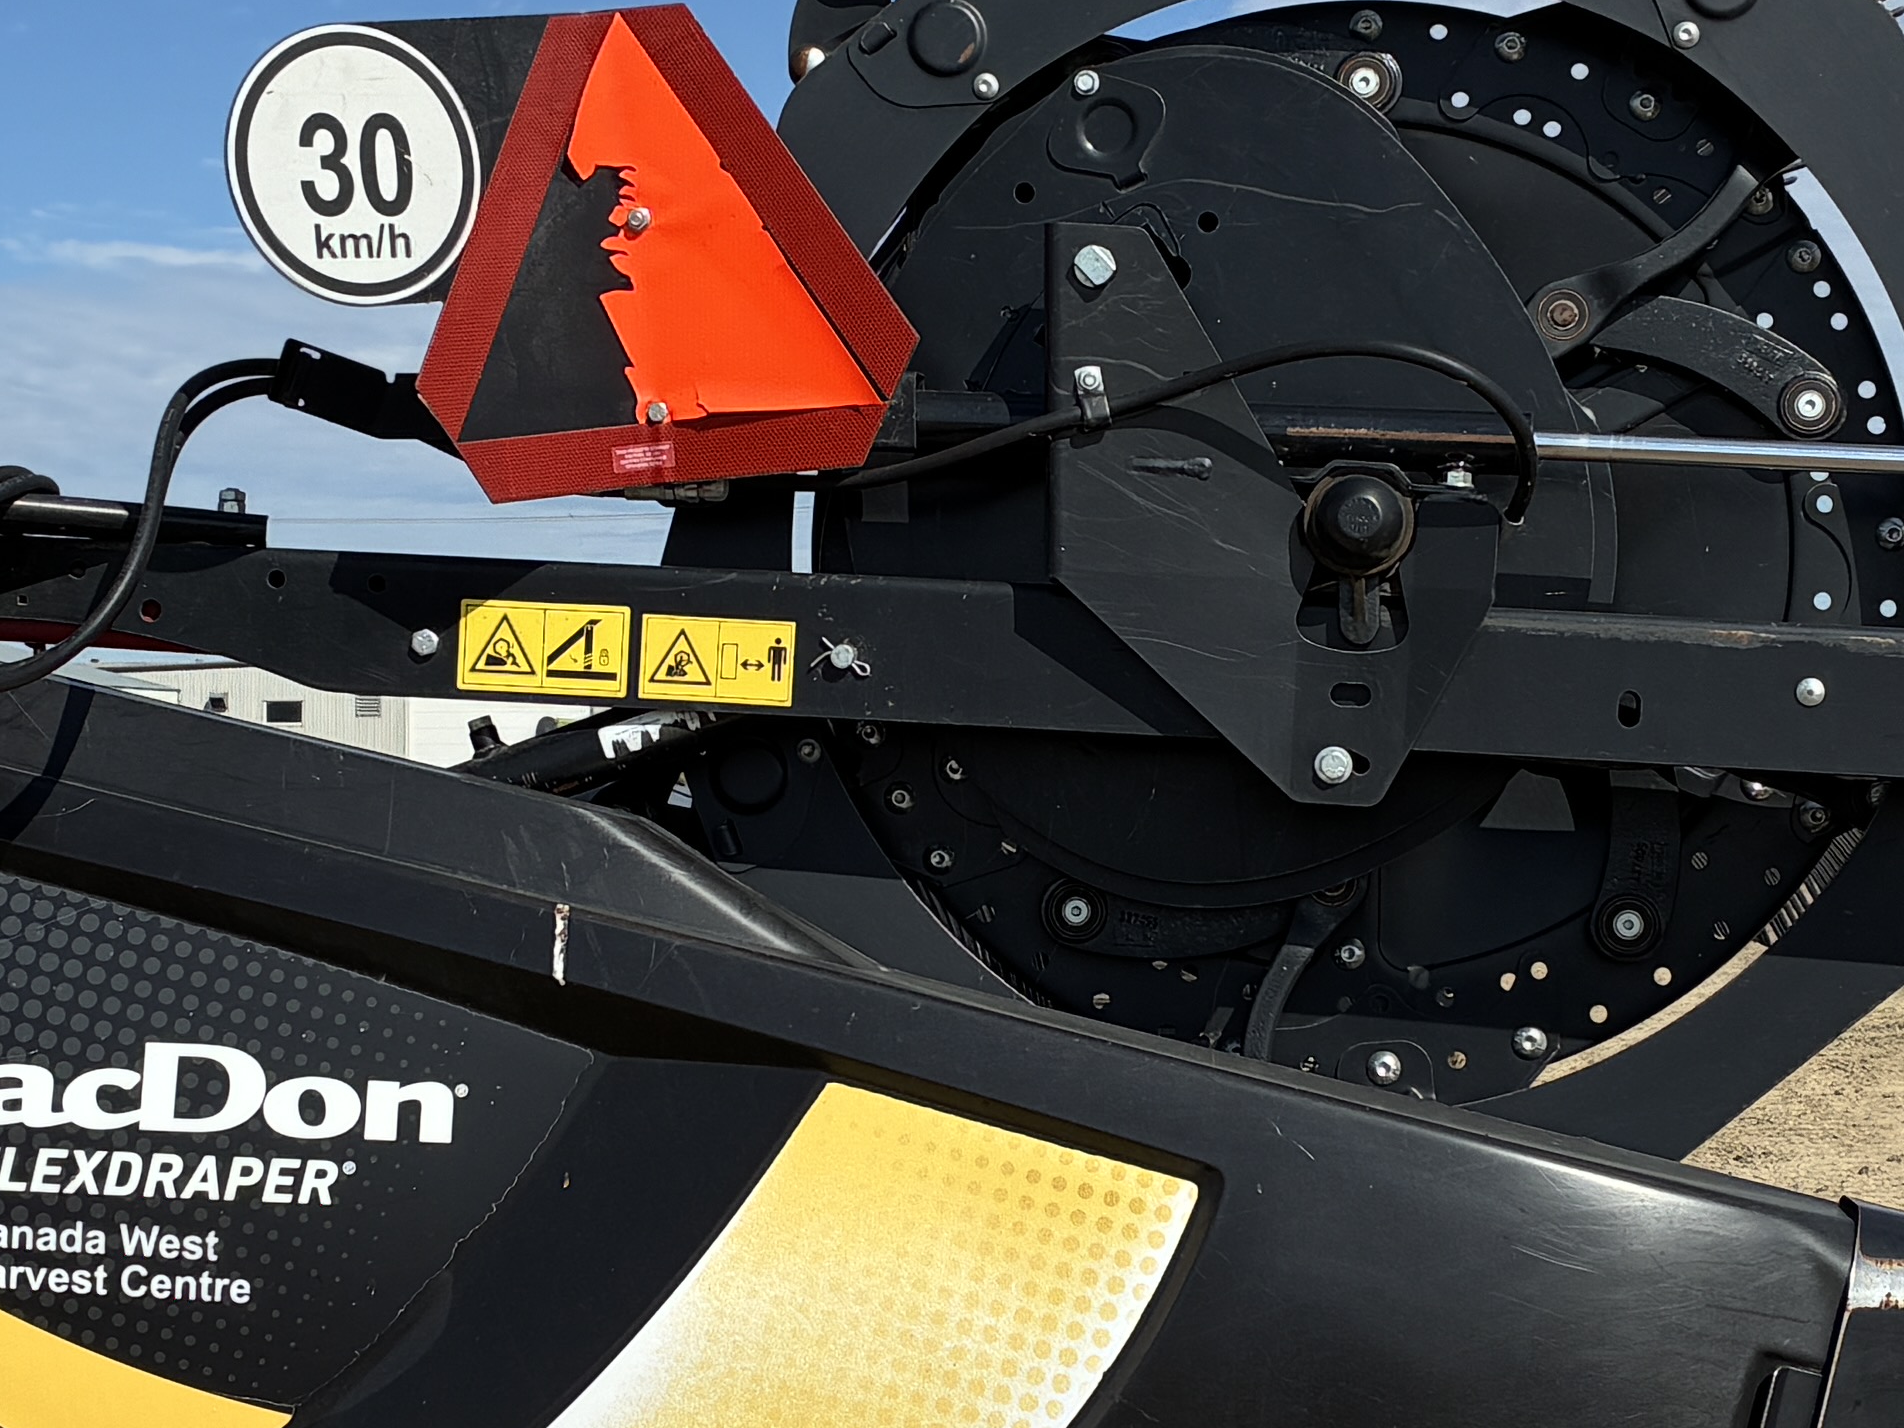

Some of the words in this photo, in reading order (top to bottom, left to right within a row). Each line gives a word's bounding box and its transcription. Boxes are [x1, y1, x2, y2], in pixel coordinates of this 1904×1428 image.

[299, 112, 413, 217] 30
[314, 223, 412, 259] km/h
[119, 1223, 219, 1262] West
[120, 1264, 251, 1304] Centre
